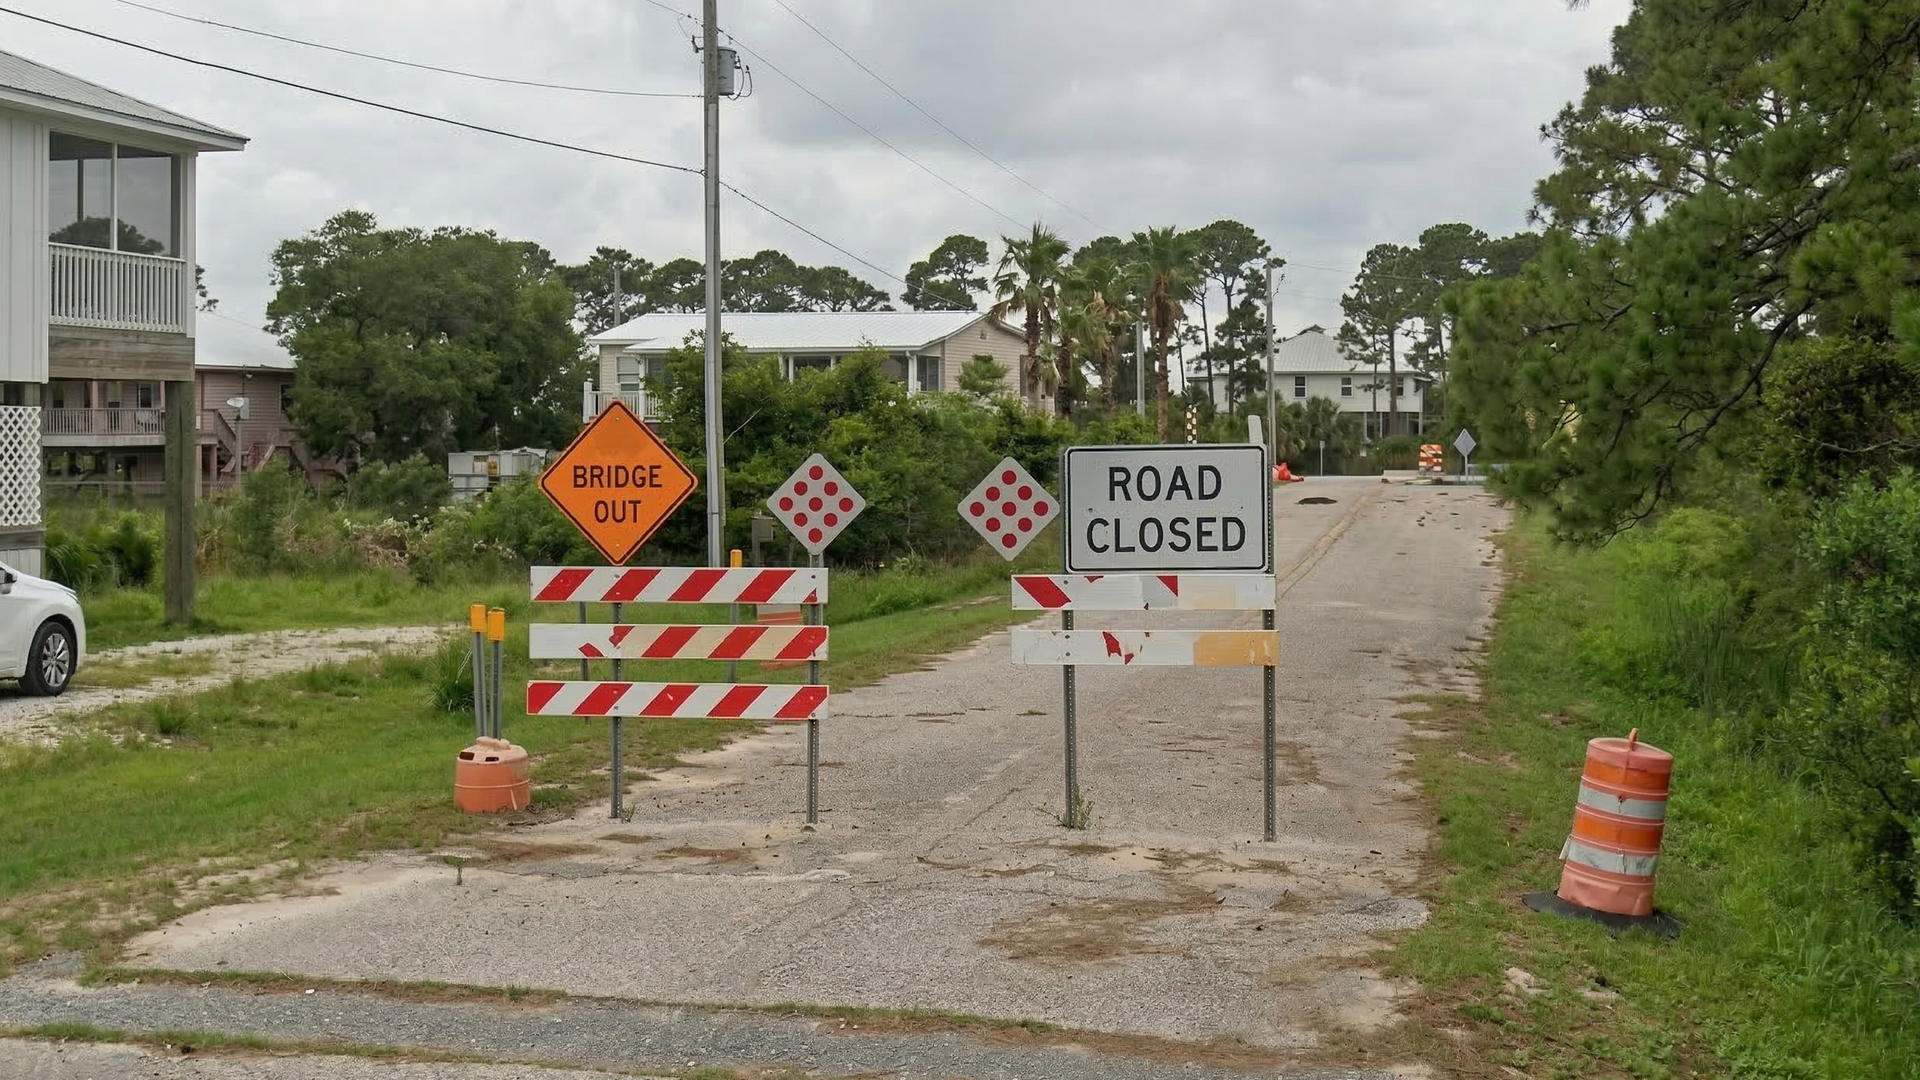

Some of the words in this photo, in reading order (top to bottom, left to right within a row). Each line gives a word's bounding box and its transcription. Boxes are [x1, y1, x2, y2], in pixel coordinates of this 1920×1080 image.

[573, 465, 662, 488] BRIDGE
[1108, 464, 1221, 502] ROAD
[594, 500, 641, 523] OUT
[1086, 516, 1246, 553] CLOSED
